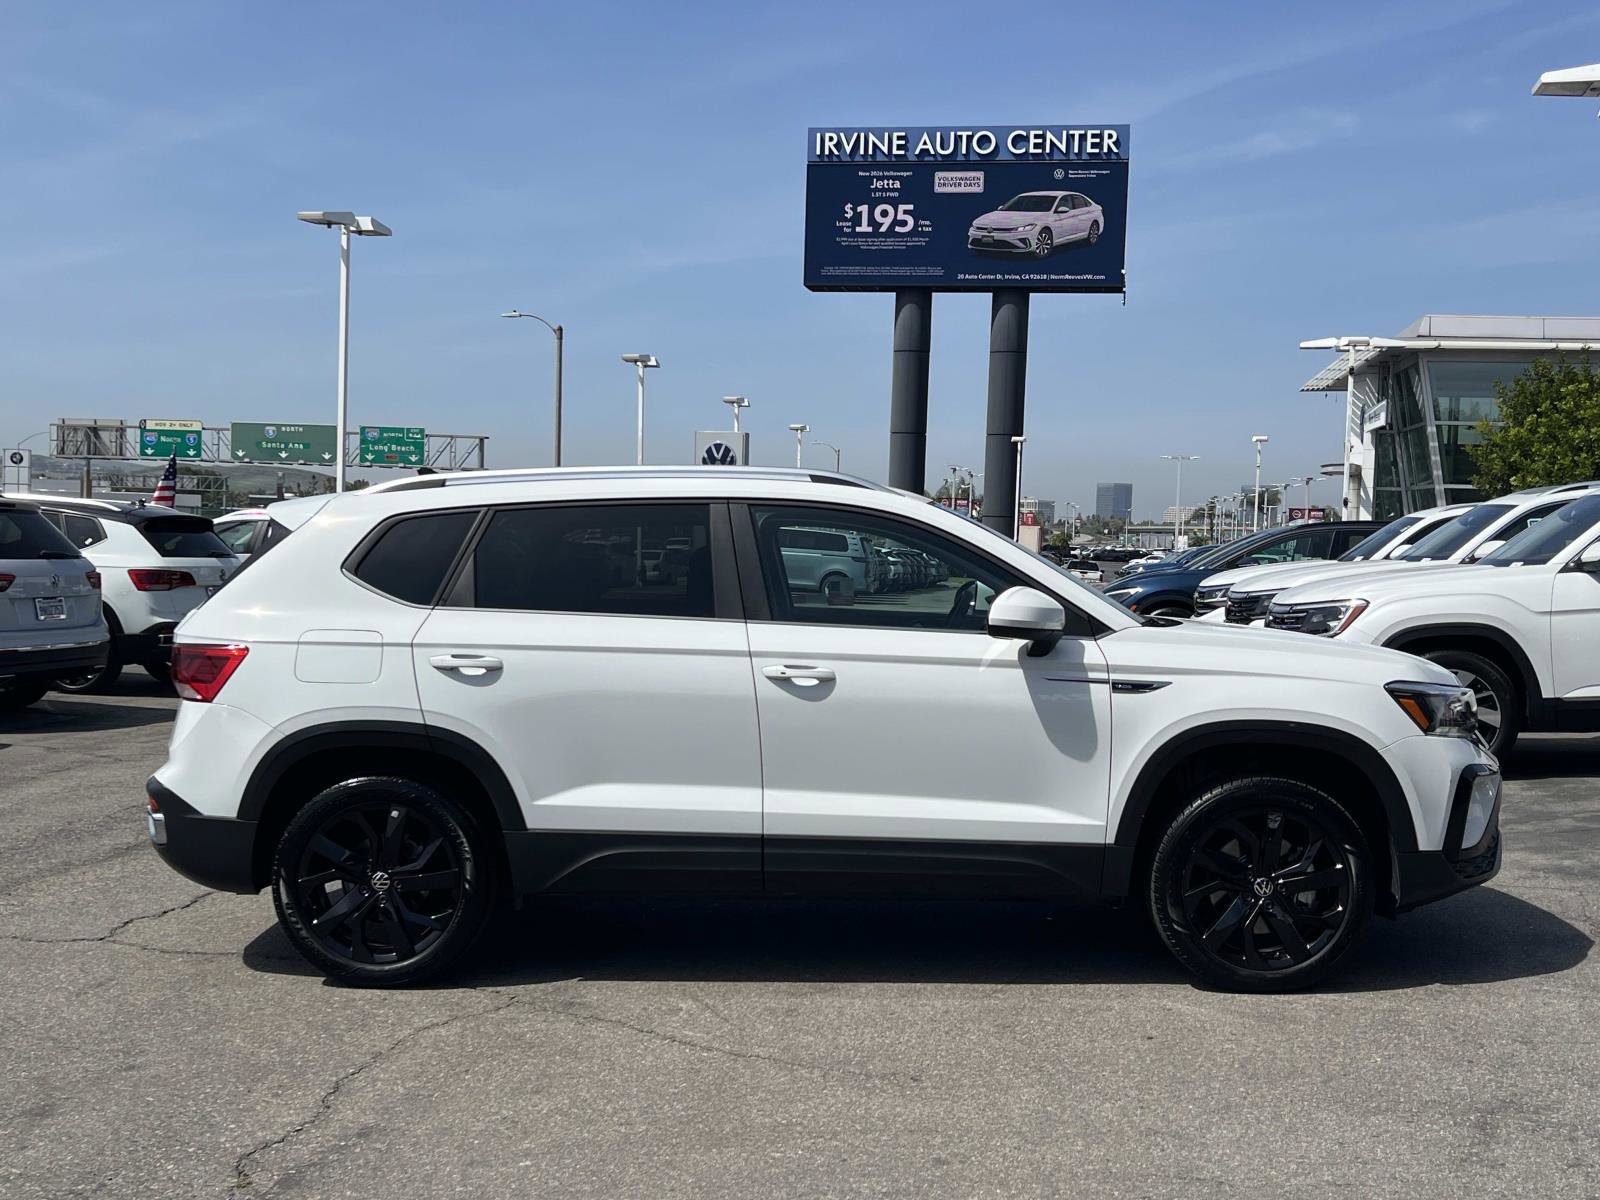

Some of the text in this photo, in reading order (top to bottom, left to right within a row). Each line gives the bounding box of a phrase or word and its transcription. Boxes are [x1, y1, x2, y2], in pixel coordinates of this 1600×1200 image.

[816, 129, 1119, 155] IRVINE AUTO CENTER
[870, 178, 901, 189] Jetta
[261, 441, 285, 449] Santa
[369, 443, 389, 452] Long
